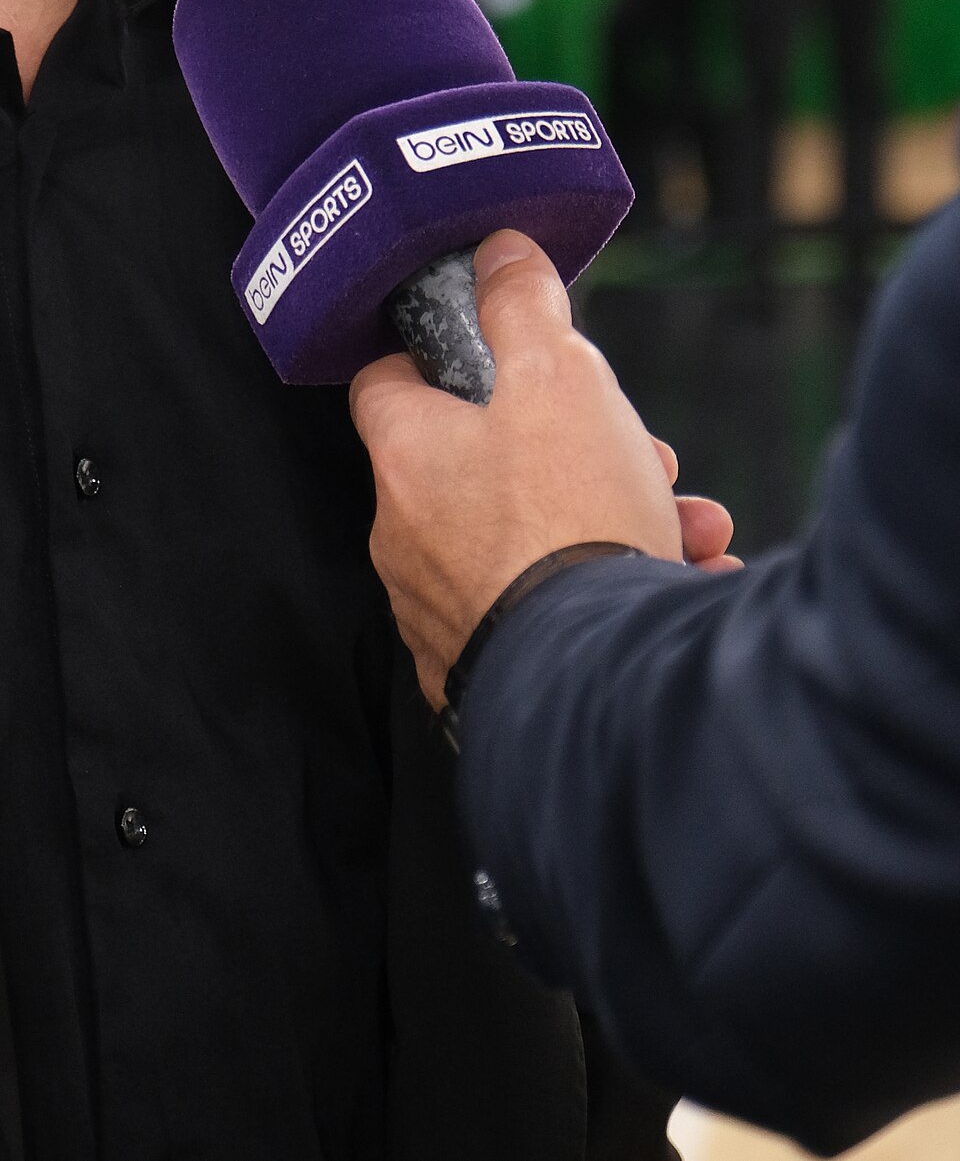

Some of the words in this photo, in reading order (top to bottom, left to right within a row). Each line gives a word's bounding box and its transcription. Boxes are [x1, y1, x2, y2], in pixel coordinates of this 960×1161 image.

[409, 126, 494, 161] beIN
[505, 119, 592, 145] SPORTS
[248, 250, 287, 312] beIN
[289, 176, 362, 257] SPORTS
